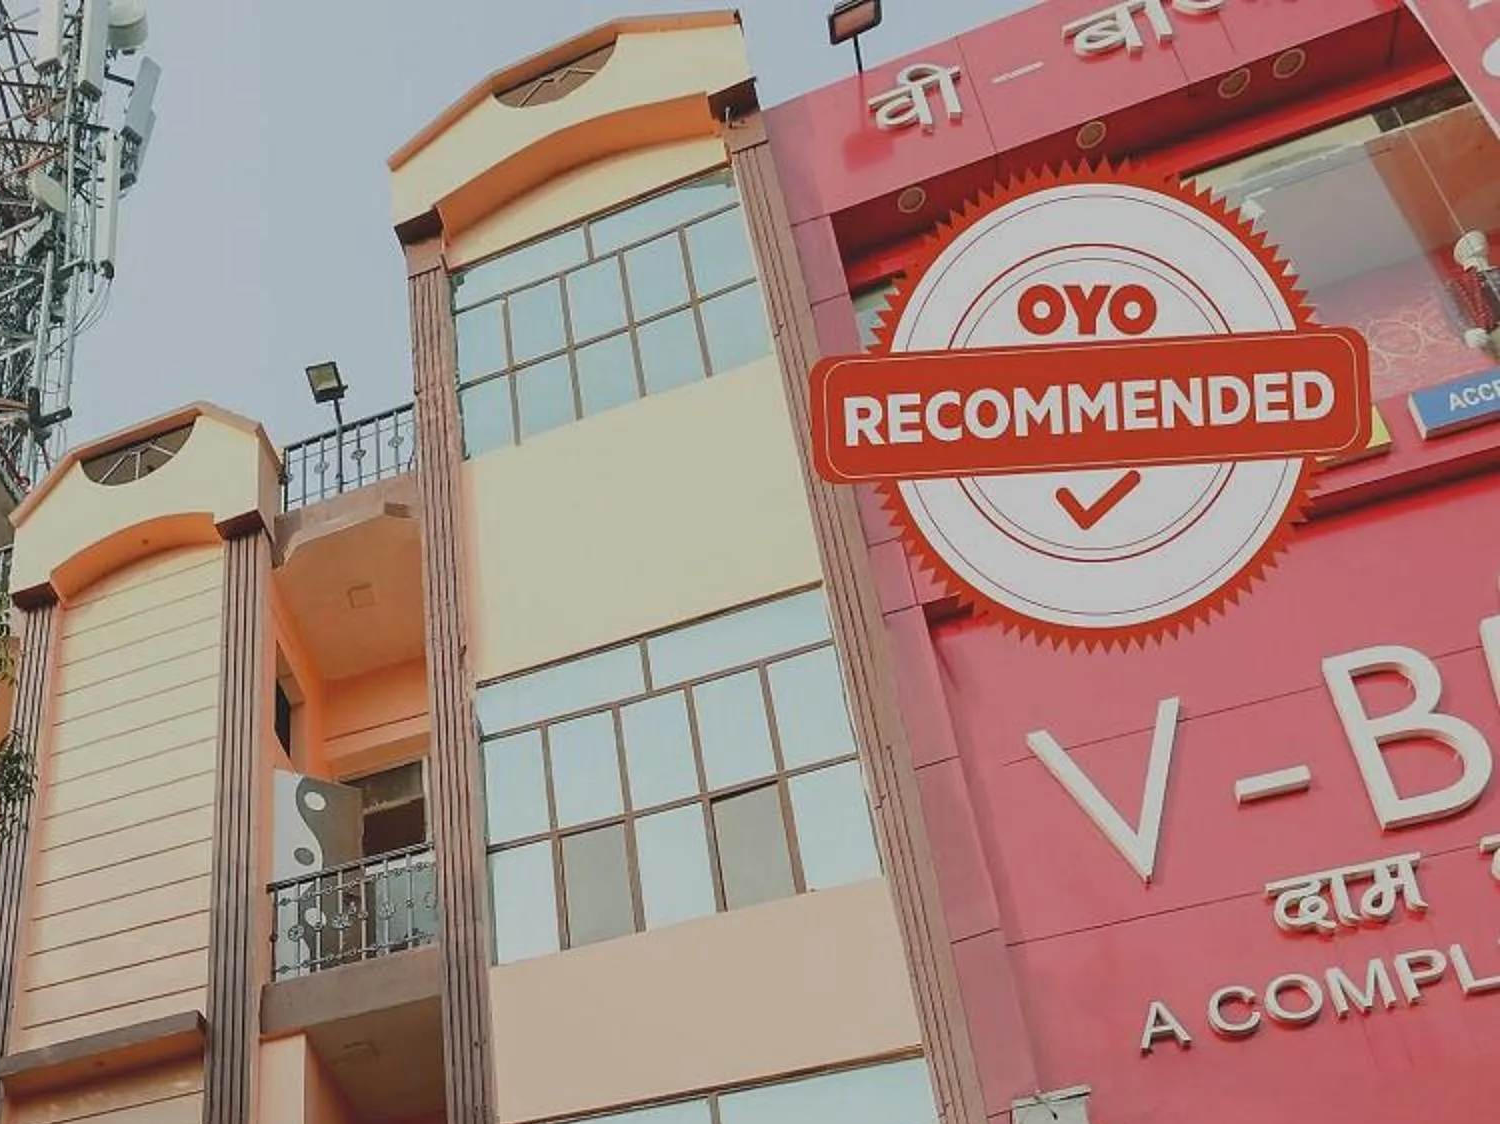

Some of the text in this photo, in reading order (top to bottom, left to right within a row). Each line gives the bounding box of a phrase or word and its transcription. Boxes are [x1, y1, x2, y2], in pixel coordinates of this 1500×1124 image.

[1265, 852, 1428, 933] दाम
[1140, 940, 1500, 1054] A COMPL
